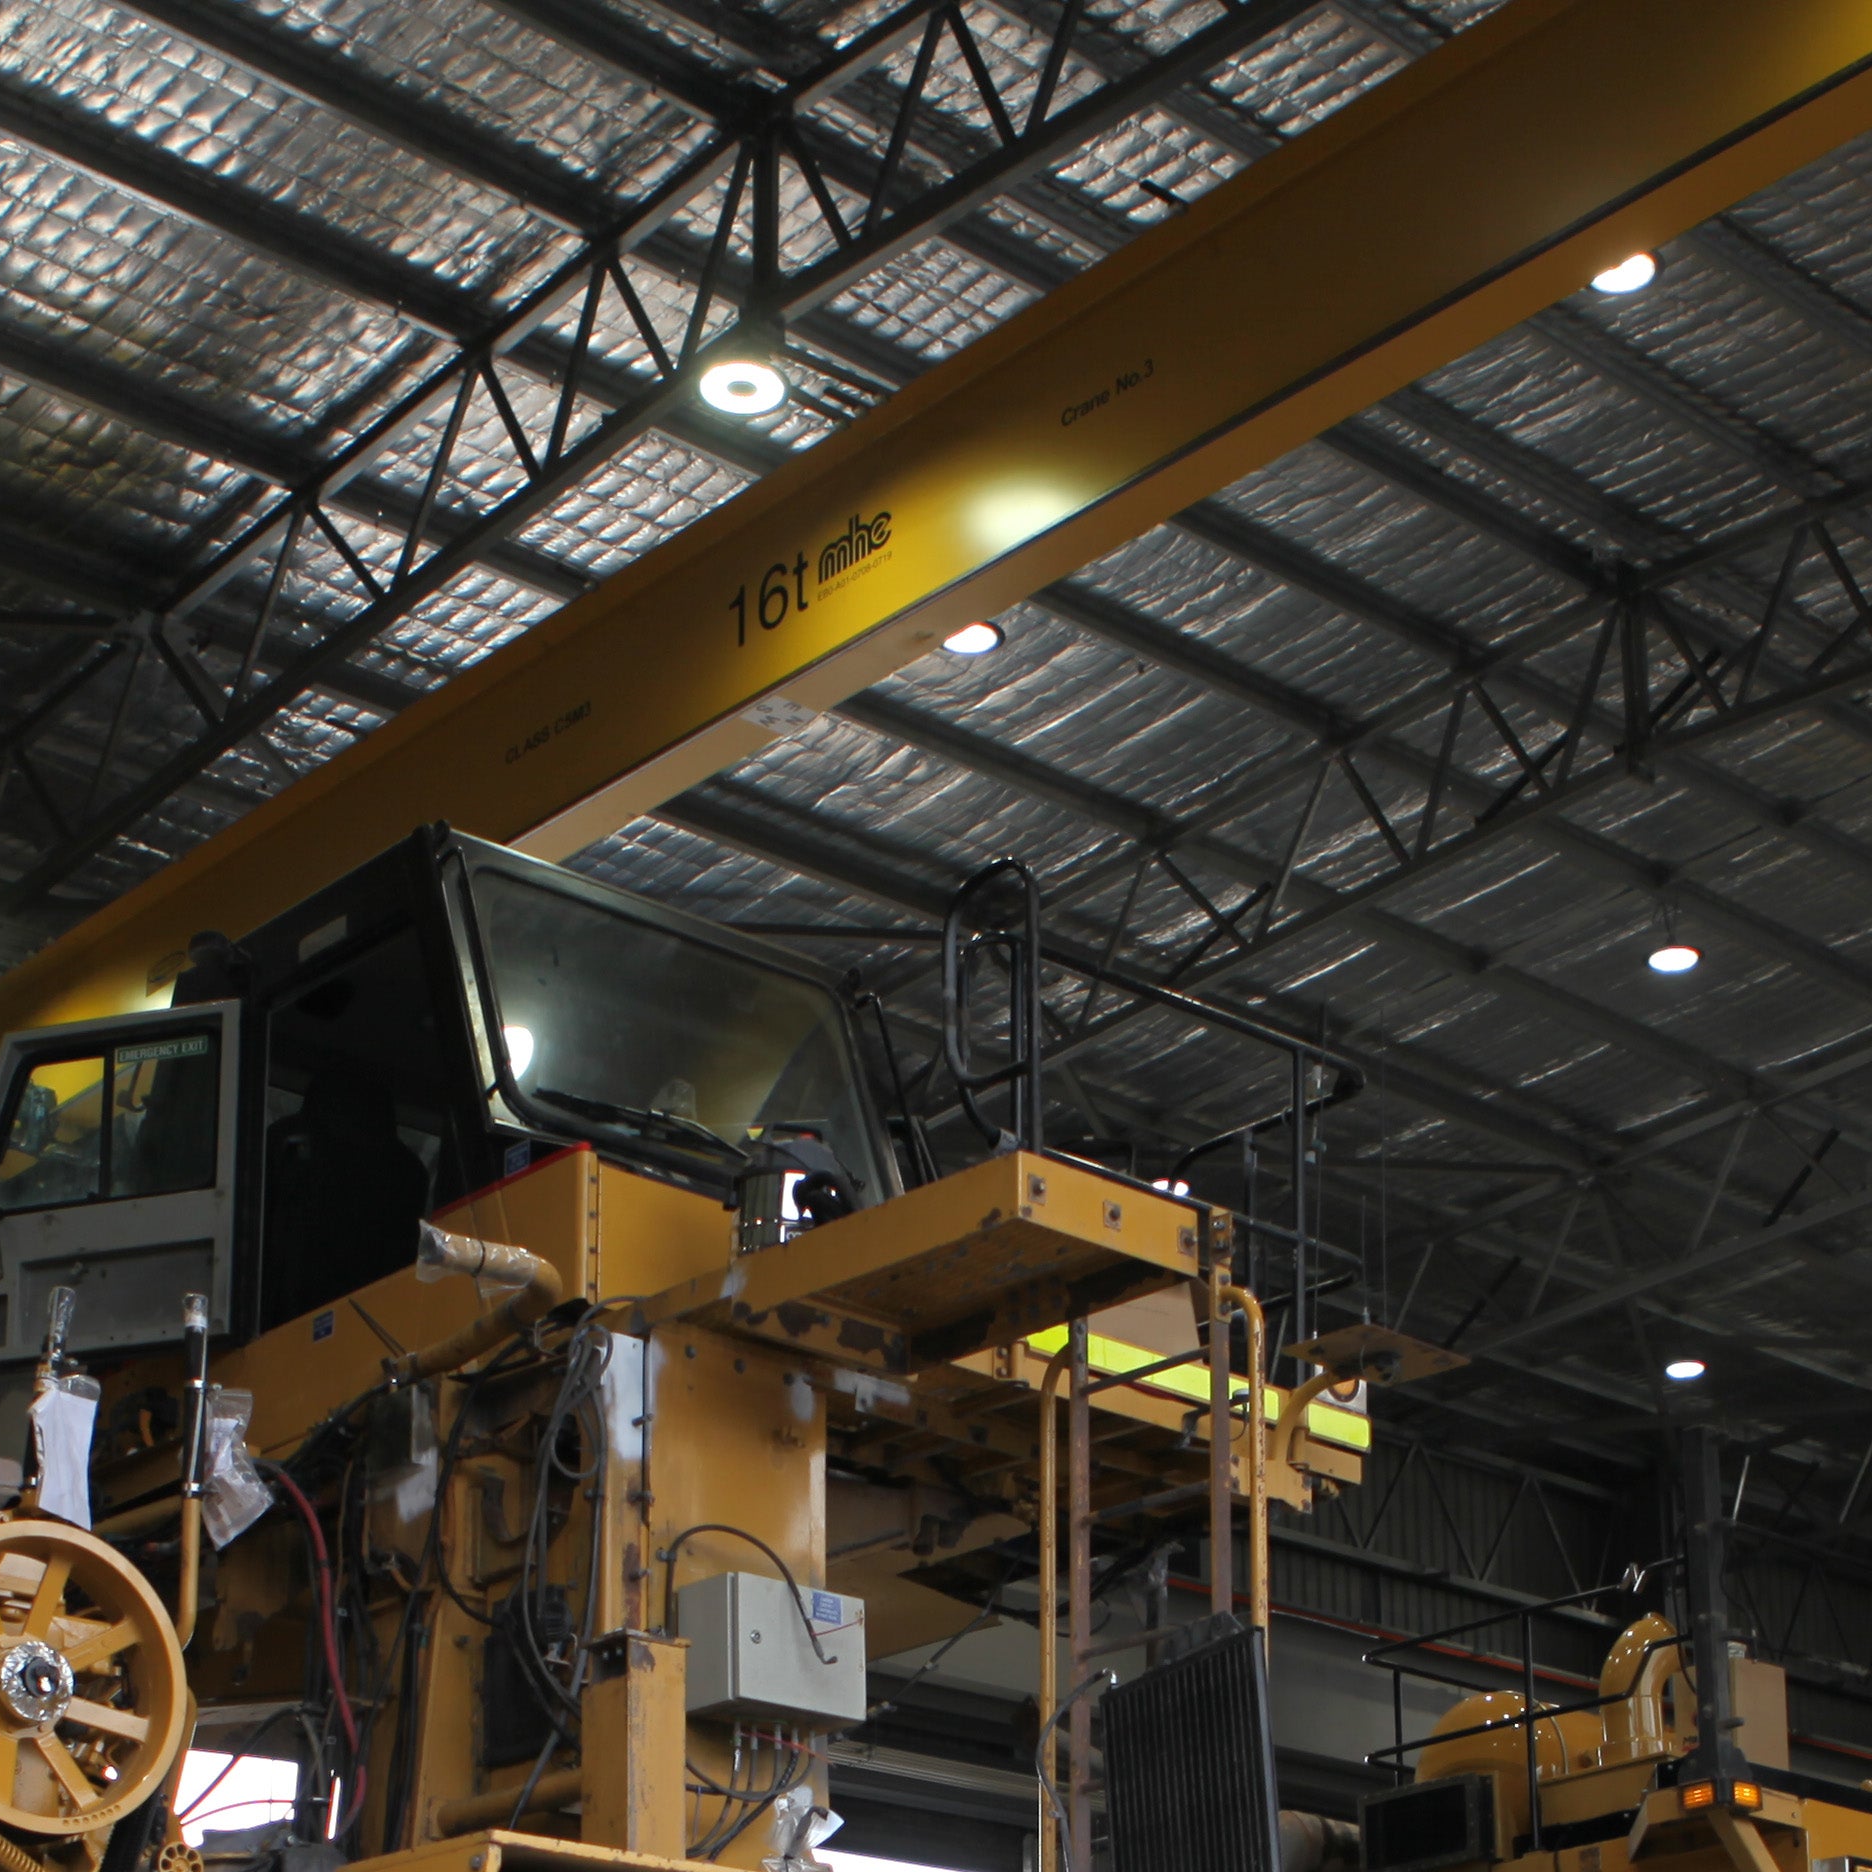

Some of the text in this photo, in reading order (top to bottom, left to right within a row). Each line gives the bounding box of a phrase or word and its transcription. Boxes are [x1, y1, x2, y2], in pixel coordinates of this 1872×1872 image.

[1061, 389, 1110, 426] Crane
[818, 511, 892, 586] mhe
[728, 550, 810, 648] 16t
[504, 728, 551, 765] CLASS
[119, 1040, 204, 1062] EMERGENCY EXIT
